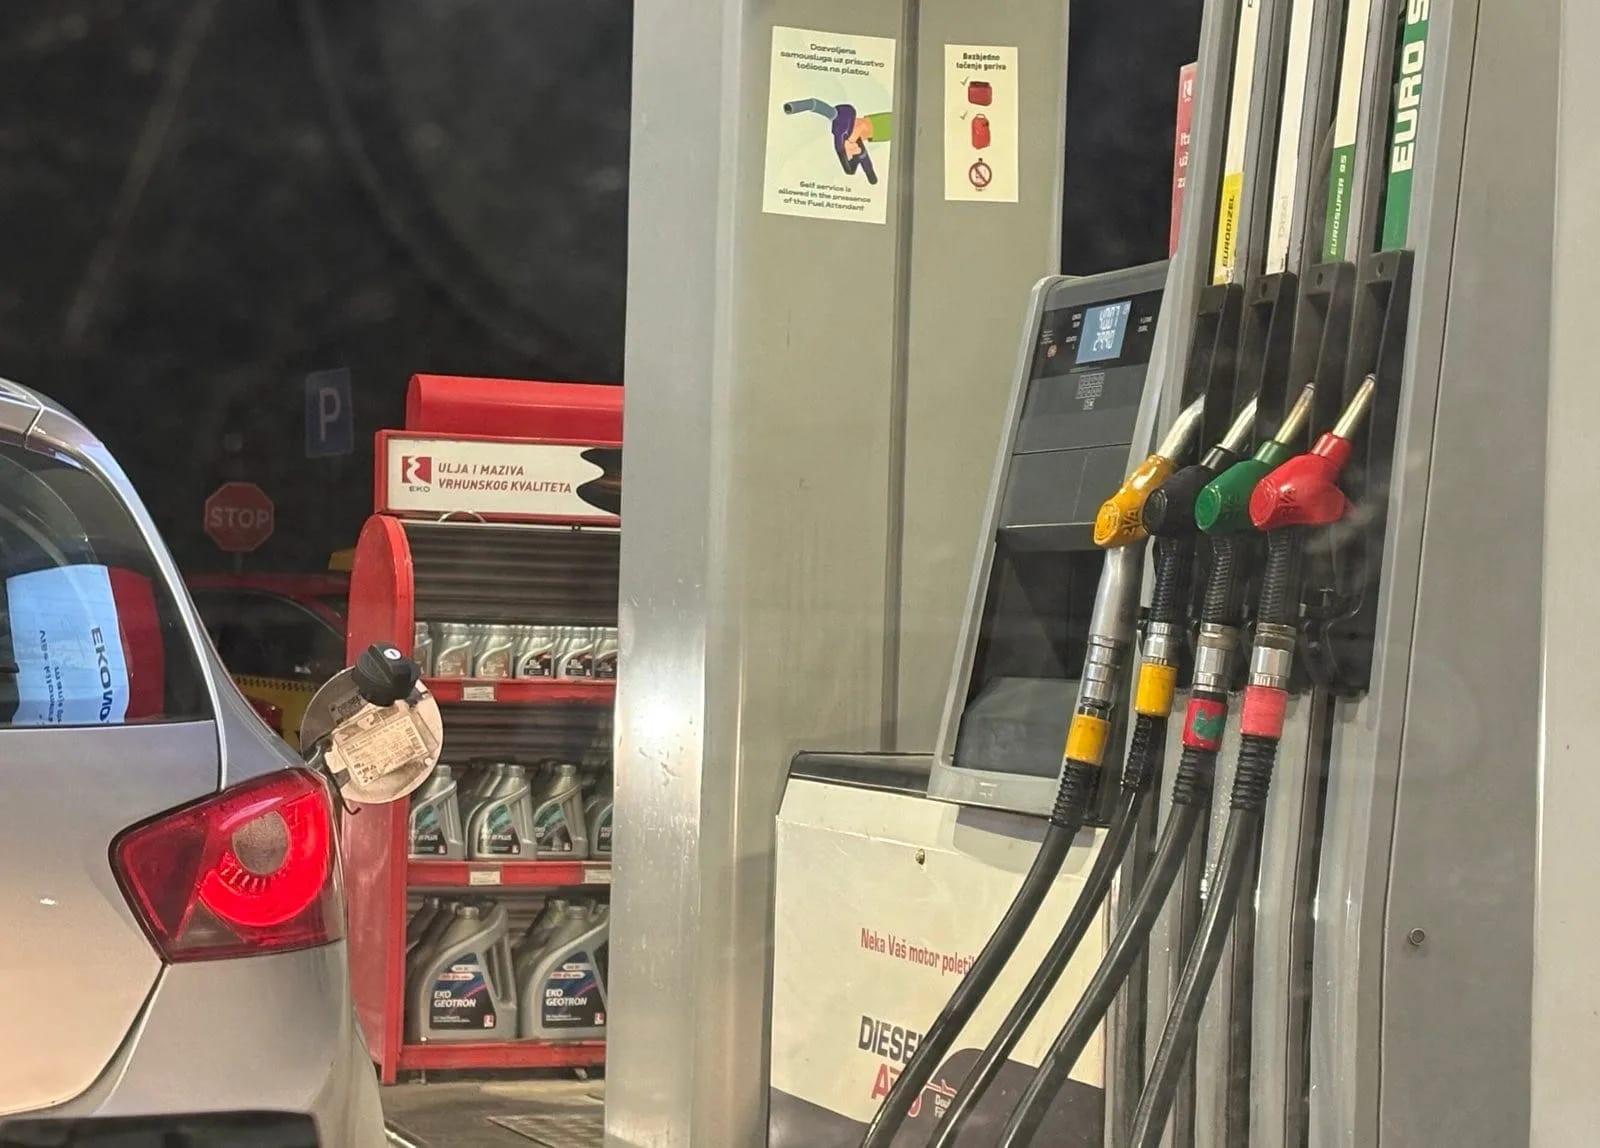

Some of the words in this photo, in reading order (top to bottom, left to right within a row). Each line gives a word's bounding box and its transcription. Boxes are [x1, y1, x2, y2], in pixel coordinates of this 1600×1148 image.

[780, 51, 832, 63] samousluga
[844, 57, 885, 68] prisustvo
[983, 62, 1006, 71] goriva
[841, 66, 869, 76] platou
[1391, 39, 1425, 174] EURO
[778, 188, 809, 197] allowed
[816, 184, 844, 192] service
[793, 198, 806, 206] the
[807, 199, 824, 208] Fuel
[825, 201, 865, 211] Attendant
[1330, 177, 1345, 256] EUROSUPER
[1222, 194, 1236, 267] EURODIZEL
[320, 387, 341, 442] P
[438, 462, 469, 474] ULJA
[472, 464, 477, 474] I
[480, 464, 524, 476] MAZIVA
[438, 478, 508, 491] VRHUNSKOG
[510, 481, 572, 493] KVALITETA
[210, 506, 270, 529] STOP
[860, 927, 886, 953] Neka
[888, 934, 907, 959] Vaš
[909, 945, 940, 969] motor
[433, 990, 452, 999] EKO
[545, 988, 563, 997] EKO
[433, 998, 477, 1008] GEOTRON
[545, 997, 588, 1006] GEOTRON
[858, 1015, 923, 1065] DIESE
